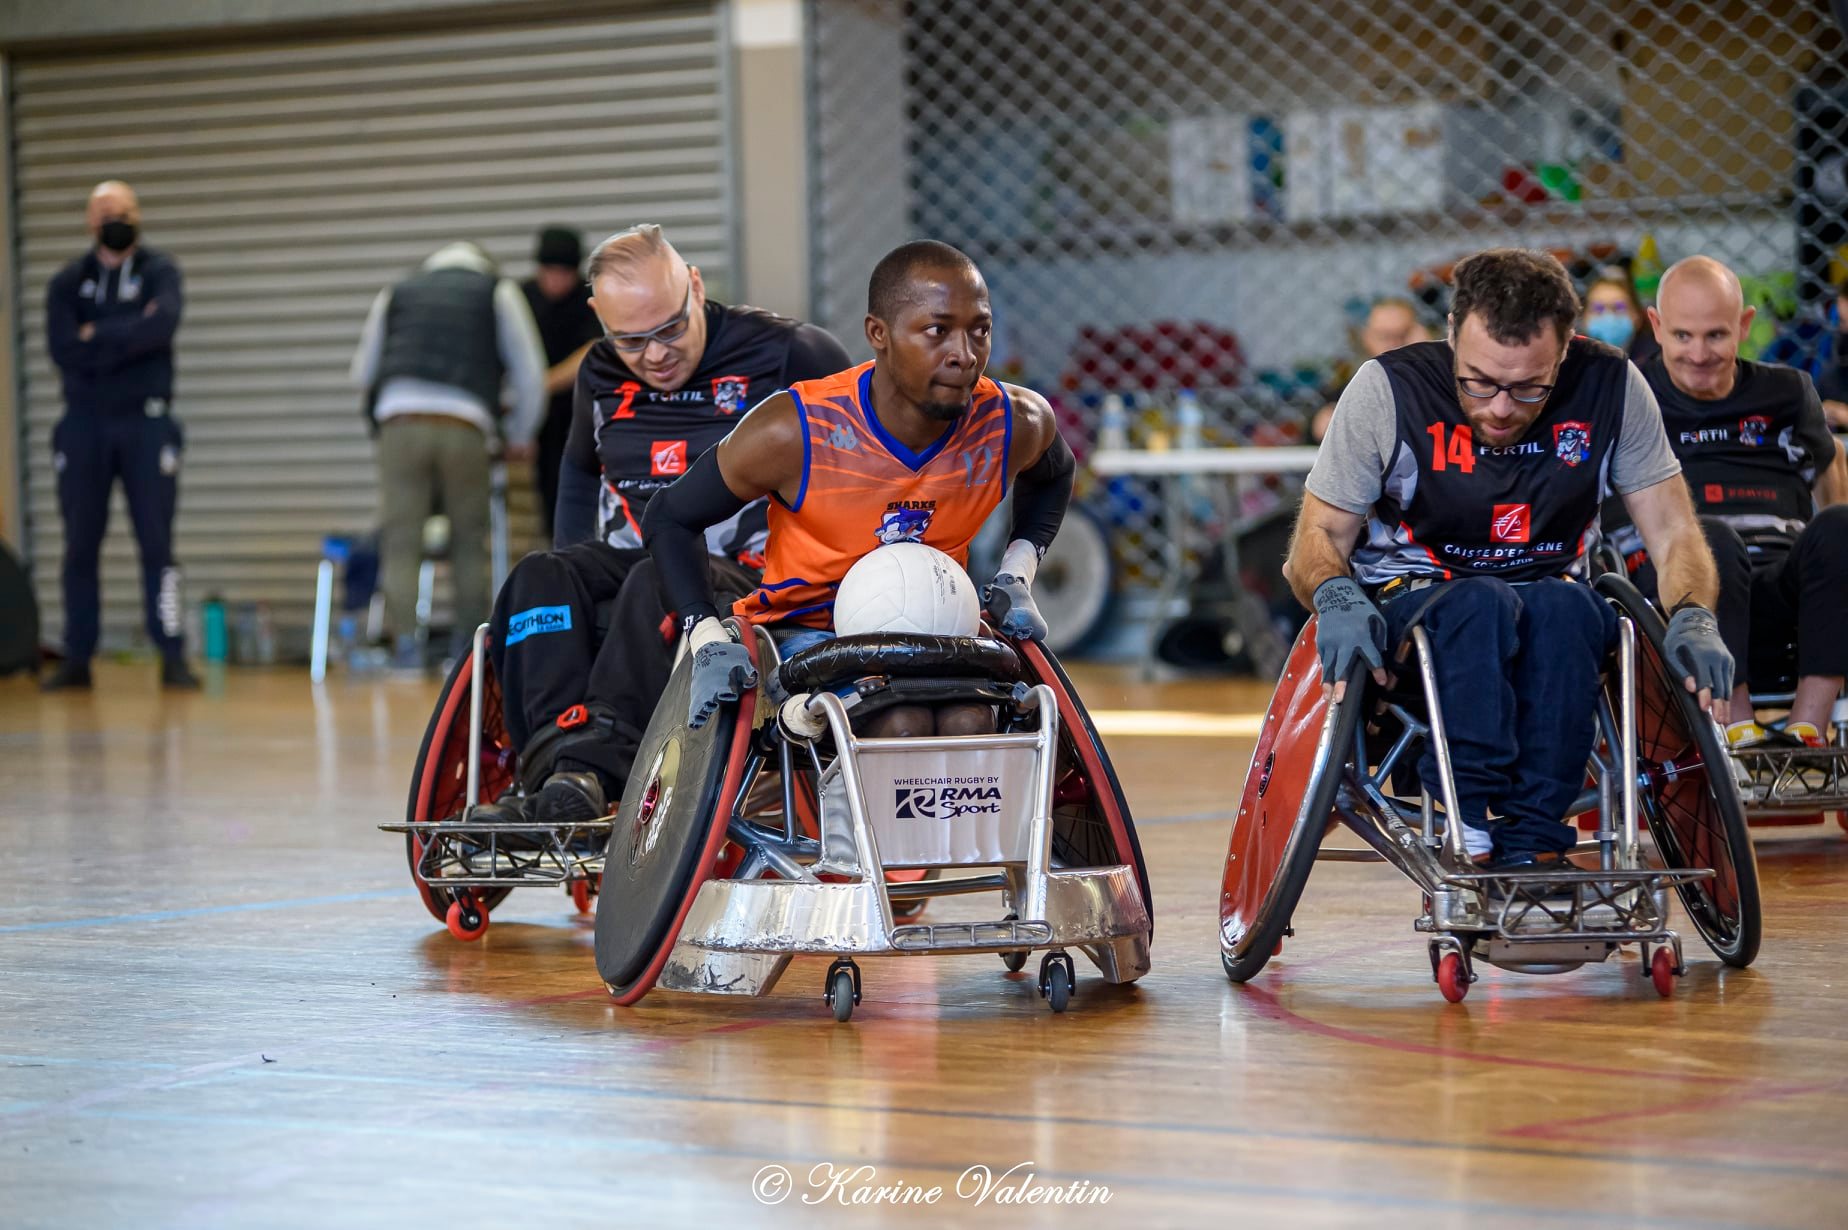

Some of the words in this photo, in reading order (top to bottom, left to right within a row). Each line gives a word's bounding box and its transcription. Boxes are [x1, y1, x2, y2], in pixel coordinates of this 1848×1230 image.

[1426, 421, 1475, 473] 14
[1479, 441, 1545, 456] FORTIL
[963, 446, 992, 488] 12
[887, 500, 937, 511] SHARKS
[1444, 544, 1491, 558] CAISSE
[1494, 541, 1563, 558] D'EPGNE
[954, 776, 984, 784] RUGBY
[987, 776, 999, 784] BY
[940, 787, 1002, 800] RMA
[940, 801, 1001, 819] Sport
